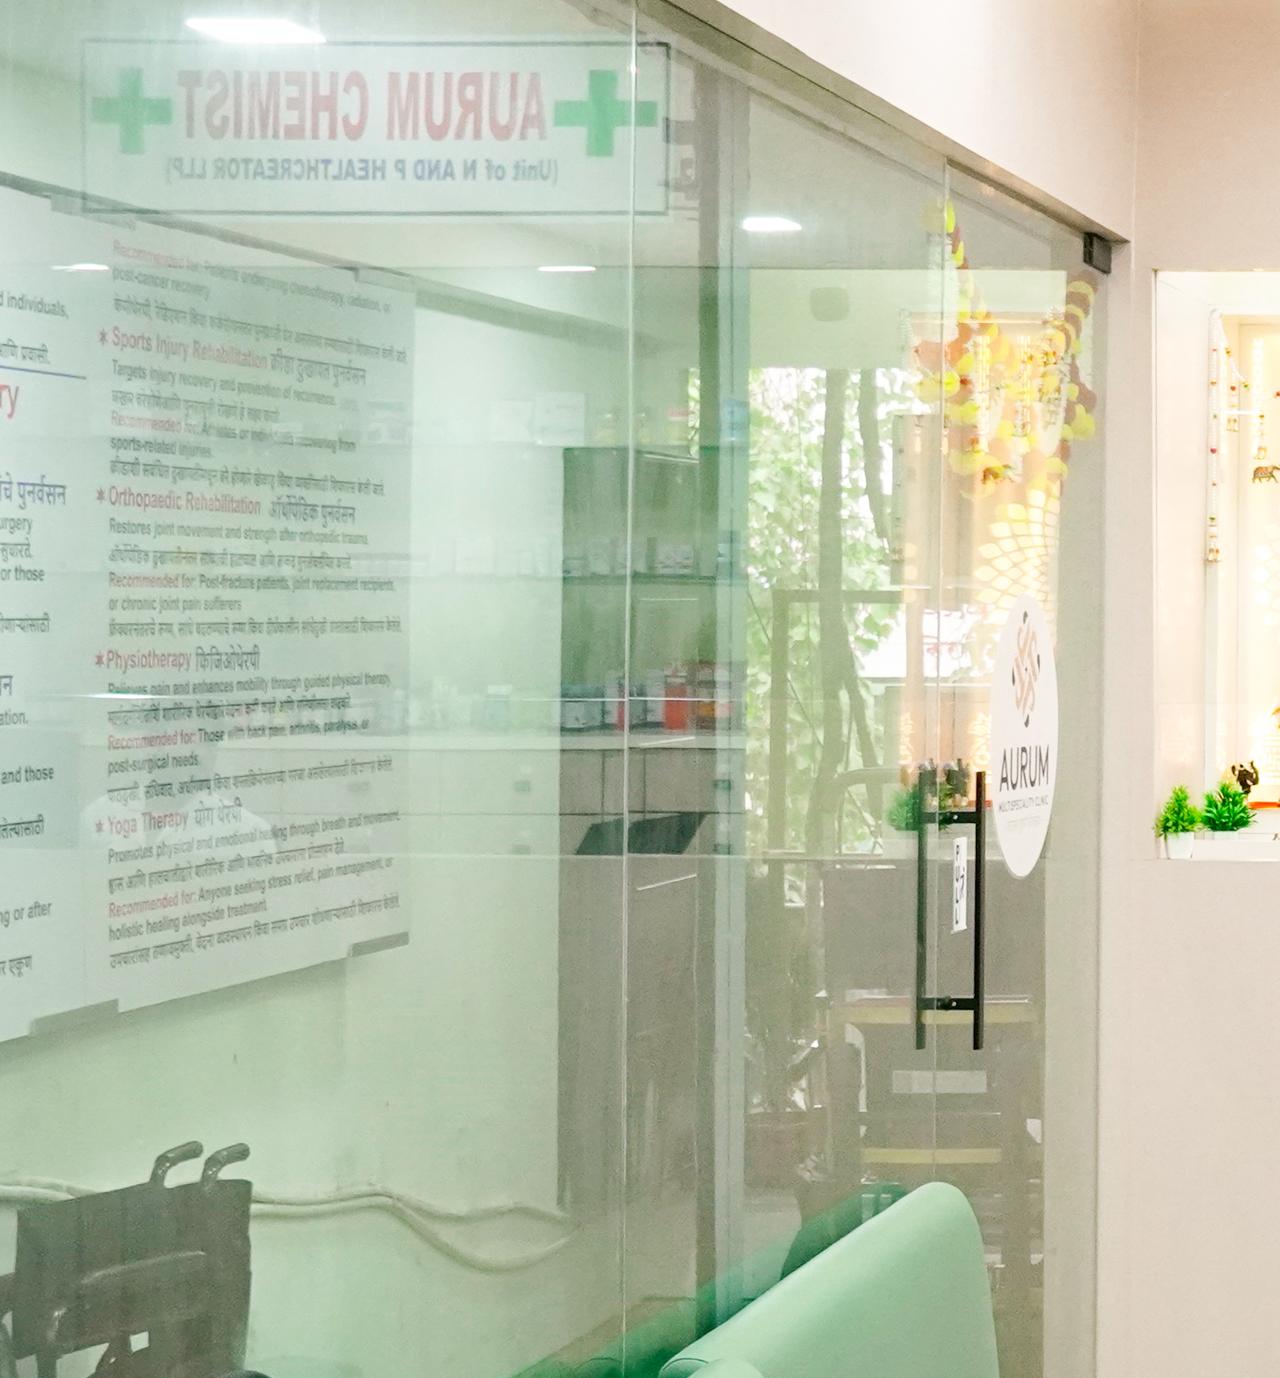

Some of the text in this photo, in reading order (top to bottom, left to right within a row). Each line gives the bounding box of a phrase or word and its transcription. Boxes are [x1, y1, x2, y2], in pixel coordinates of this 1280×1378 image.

[7, 293, 69, 320] individuals,
[112, 325, 153, 351] Sports
[156, 333, 188, 362] Injury
[193, 338, 268, 369] Rehabilitation
[112, 358, 148, 381] Targets
[149, 367, 175, 387] injury
[219, 377, 236, 392] and
[111, 409, 182, 434] Recommended
[110, 436, 177, 456] sports-related
[17, 474, 67, 510] पुनर्वसन
[109, 485, 182, 511] Orthopaedic
[185, 491, 261, 516] Rehabilitation
[320, 498, 356, 529] पुनर्वसन
[109, 517, 152, 536] Restores
[153, 521, 175, 539] joint
[177, 525, 223, 538] movement
[225, 527, 242, 539] and
[243, 528, 278, 545] strength
[14, 564, 46, 583] those
[109, 571, 180, 588] Recommended
[311, 577, 359, 592] replacement
[109, 599, 119, 611] or
[121, 596, 157, 611] chronic
[159, 595, 180, 614] joint
[182, 596, 202, 613] pain
[106, 649, 192, 675] Physiotherapy
[195, 643, 261, 673] फिजिओथेरपी
[150, 680, 171, 696] pain
[172, 680, 190, 695] and
[191, 679, 235, 695] enhances
[235, 675, 268, 694] mobility
[270, 675, 303, 693] through
[303, 674, 331, 693] guided
[331, 671, 364, 692] physical
[107, 730, 178, 751] Recommended
[179, 729, 197, 745] for:
[197, 727, 226, 744] Those
[227, 725, 245, 740] with
[1, 765, 55, 784] and those
[107, 753, 170, 778] post-surgical
[999, 744, 1049, 793] AURUM
[107, 810, 189, 839] Yoga Therapy
[194, 796, 244, 826] योग थेरपी
[108, 844, 154, 864] Promotes
[155, 836, 195, 860] physical
[196, 835, 213, 851] and
[214, 828, 257, 848] emotional
[289, 820, 320, 838] through
[321, 816, 347, 833] breath
[347, 813, 362, 828] and
[108, 892, 179, 918] Recommended
[180, 889, 197, 905] for:
[197, 885, 233, 904] Anyone
[233, 878, 266, 897] seeking
[267, 873, 293, 889] stress
[317, 866, 334, 882] pain
[384, 856, 394, 868] or
[13, 900, 53, 923] or after
[108, 922, 145, 942] holistic
[145, 915, 181, 935] healing
[181, 908, 225, 928] alongside
